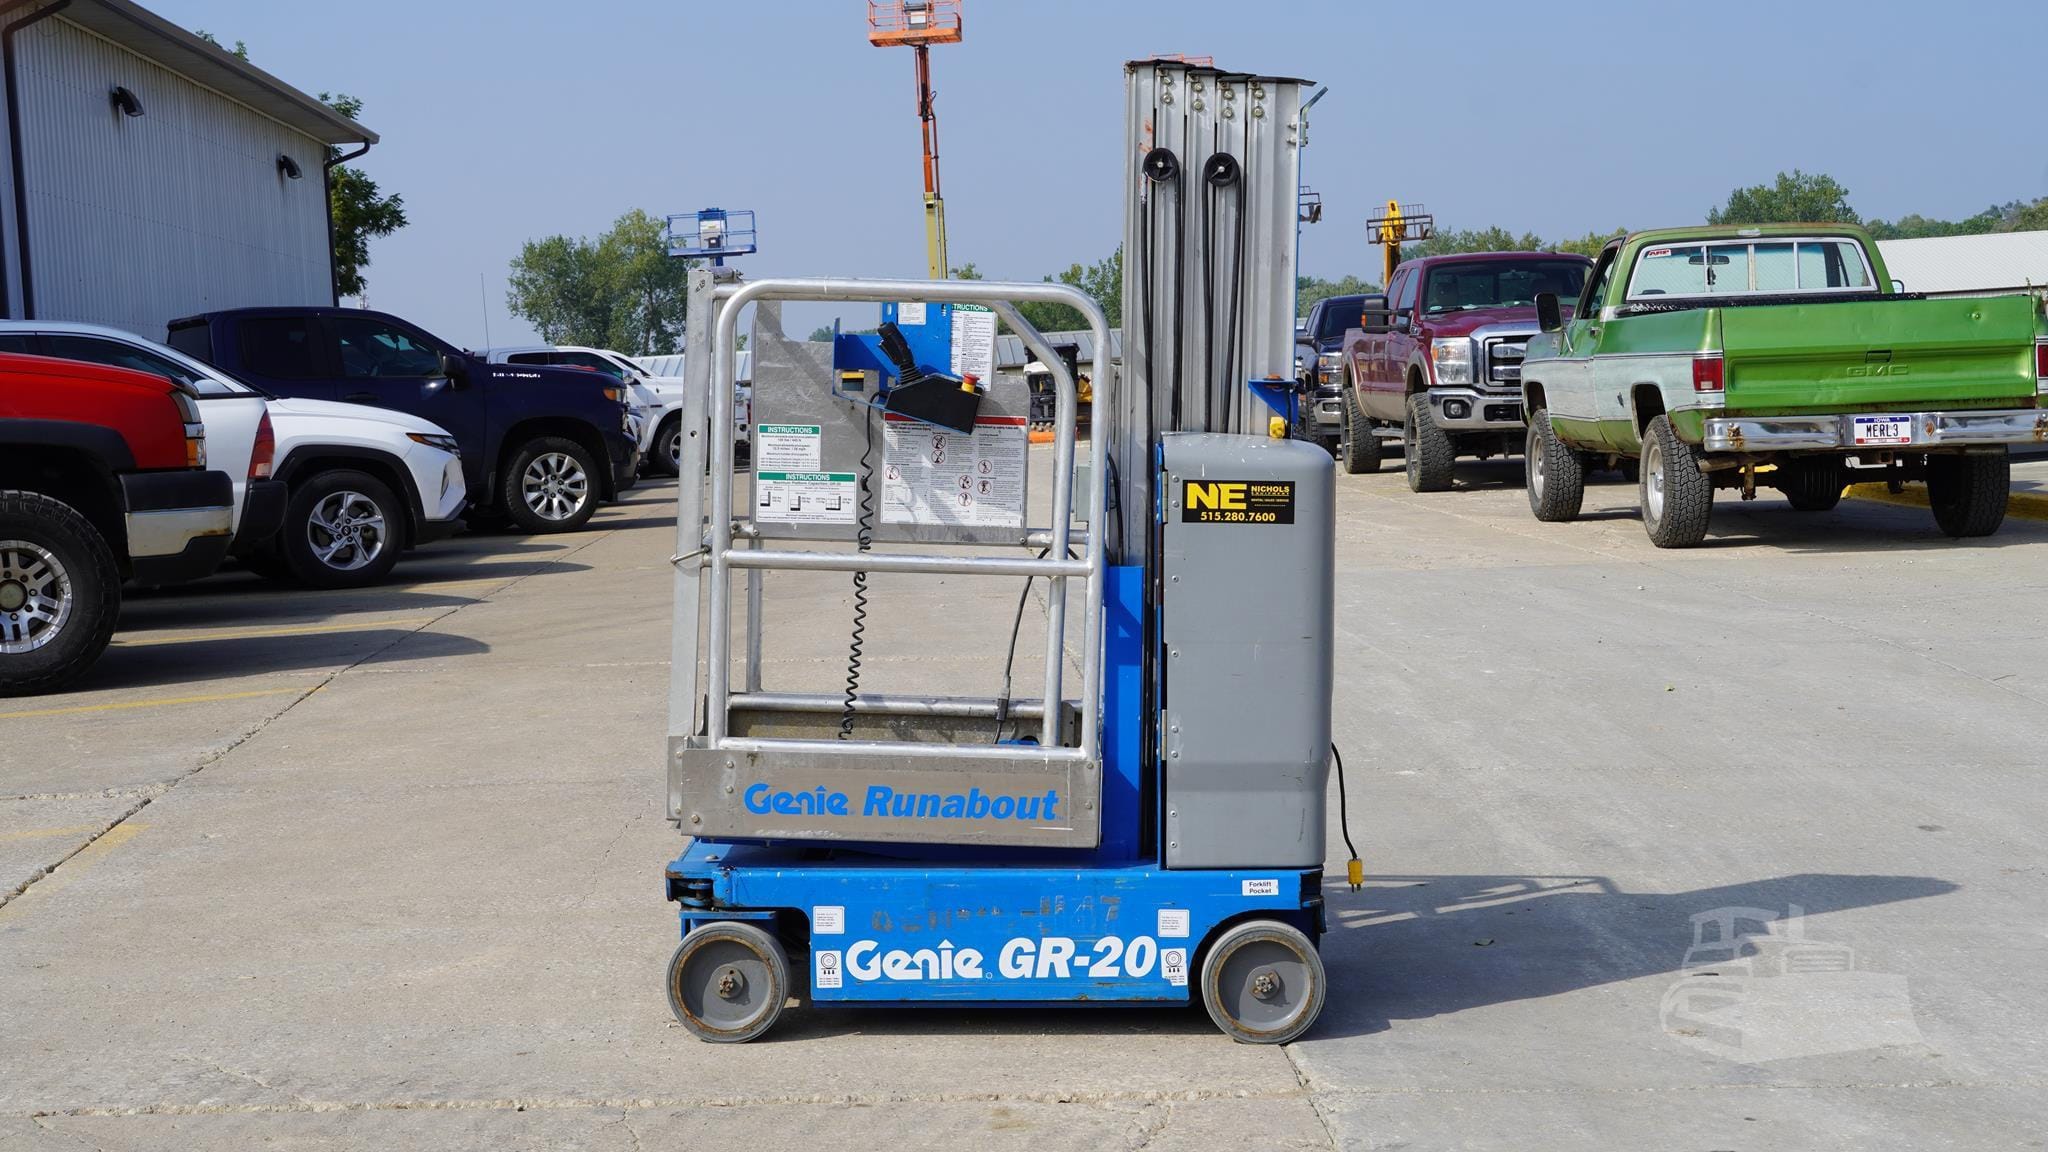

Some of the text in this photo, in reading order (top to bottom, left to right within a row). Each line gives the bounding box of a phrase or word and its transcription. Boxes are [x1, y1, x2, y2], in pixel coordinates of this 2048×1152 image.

[1846, 364, 1909, 378] GMC
[767, 426, 813, 434] INSTRUCTIONS
[1865, 423, 1899, 438] MERL3
[785, 473, 831, 481] INSTRUCTIONS
[1186, 482, 1247, 510] NE
[1250, 485, 1290, 493] NICHOLS
[1200, 511, 1276, 522] 515.280.7600
[744, 783, 1059, 821] Genie Runabout
[845, 935, 1158, 981] Genie GR-20
